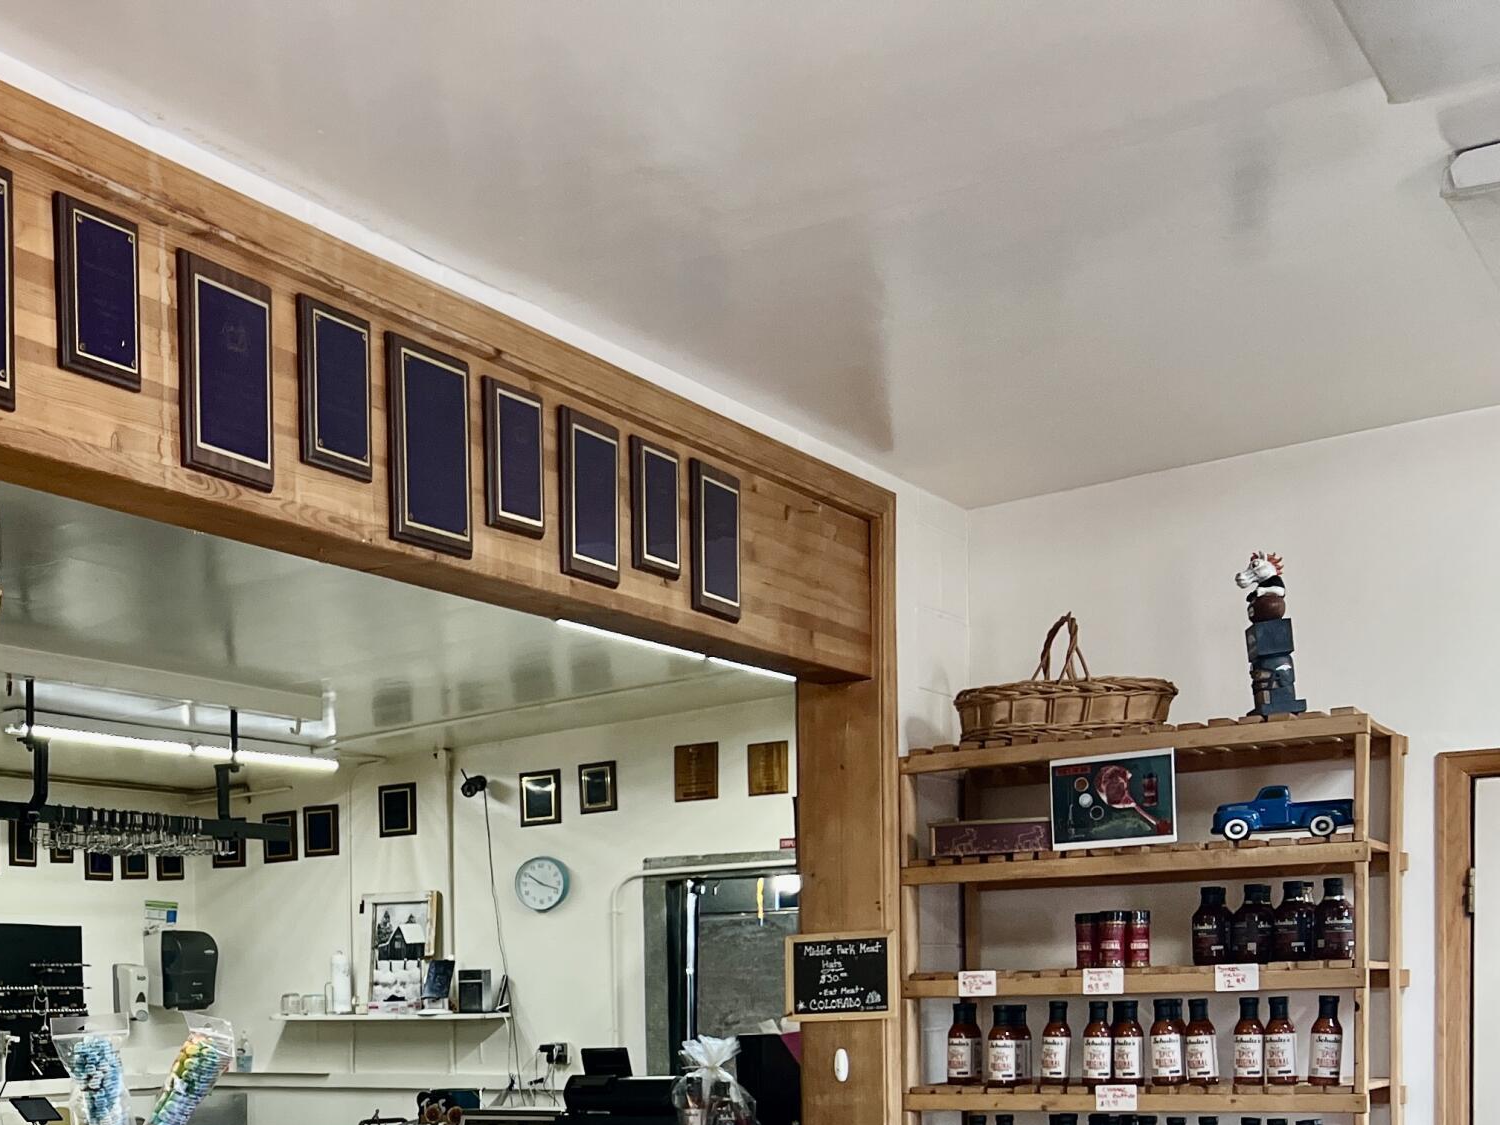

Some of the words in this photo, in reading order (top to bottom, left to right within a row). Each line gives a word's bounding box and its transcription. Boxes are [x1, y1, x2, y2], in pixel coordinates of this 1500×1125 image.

[804, 945, 832, 956] Middle
[836, 943, 856, 955] Park
[859, 941, 882, 953] Meat
[821, 959, 842, 969] Hats
[840, 985, 860, 994] Meat
[809, 997, 861, 1010] COLORADO
